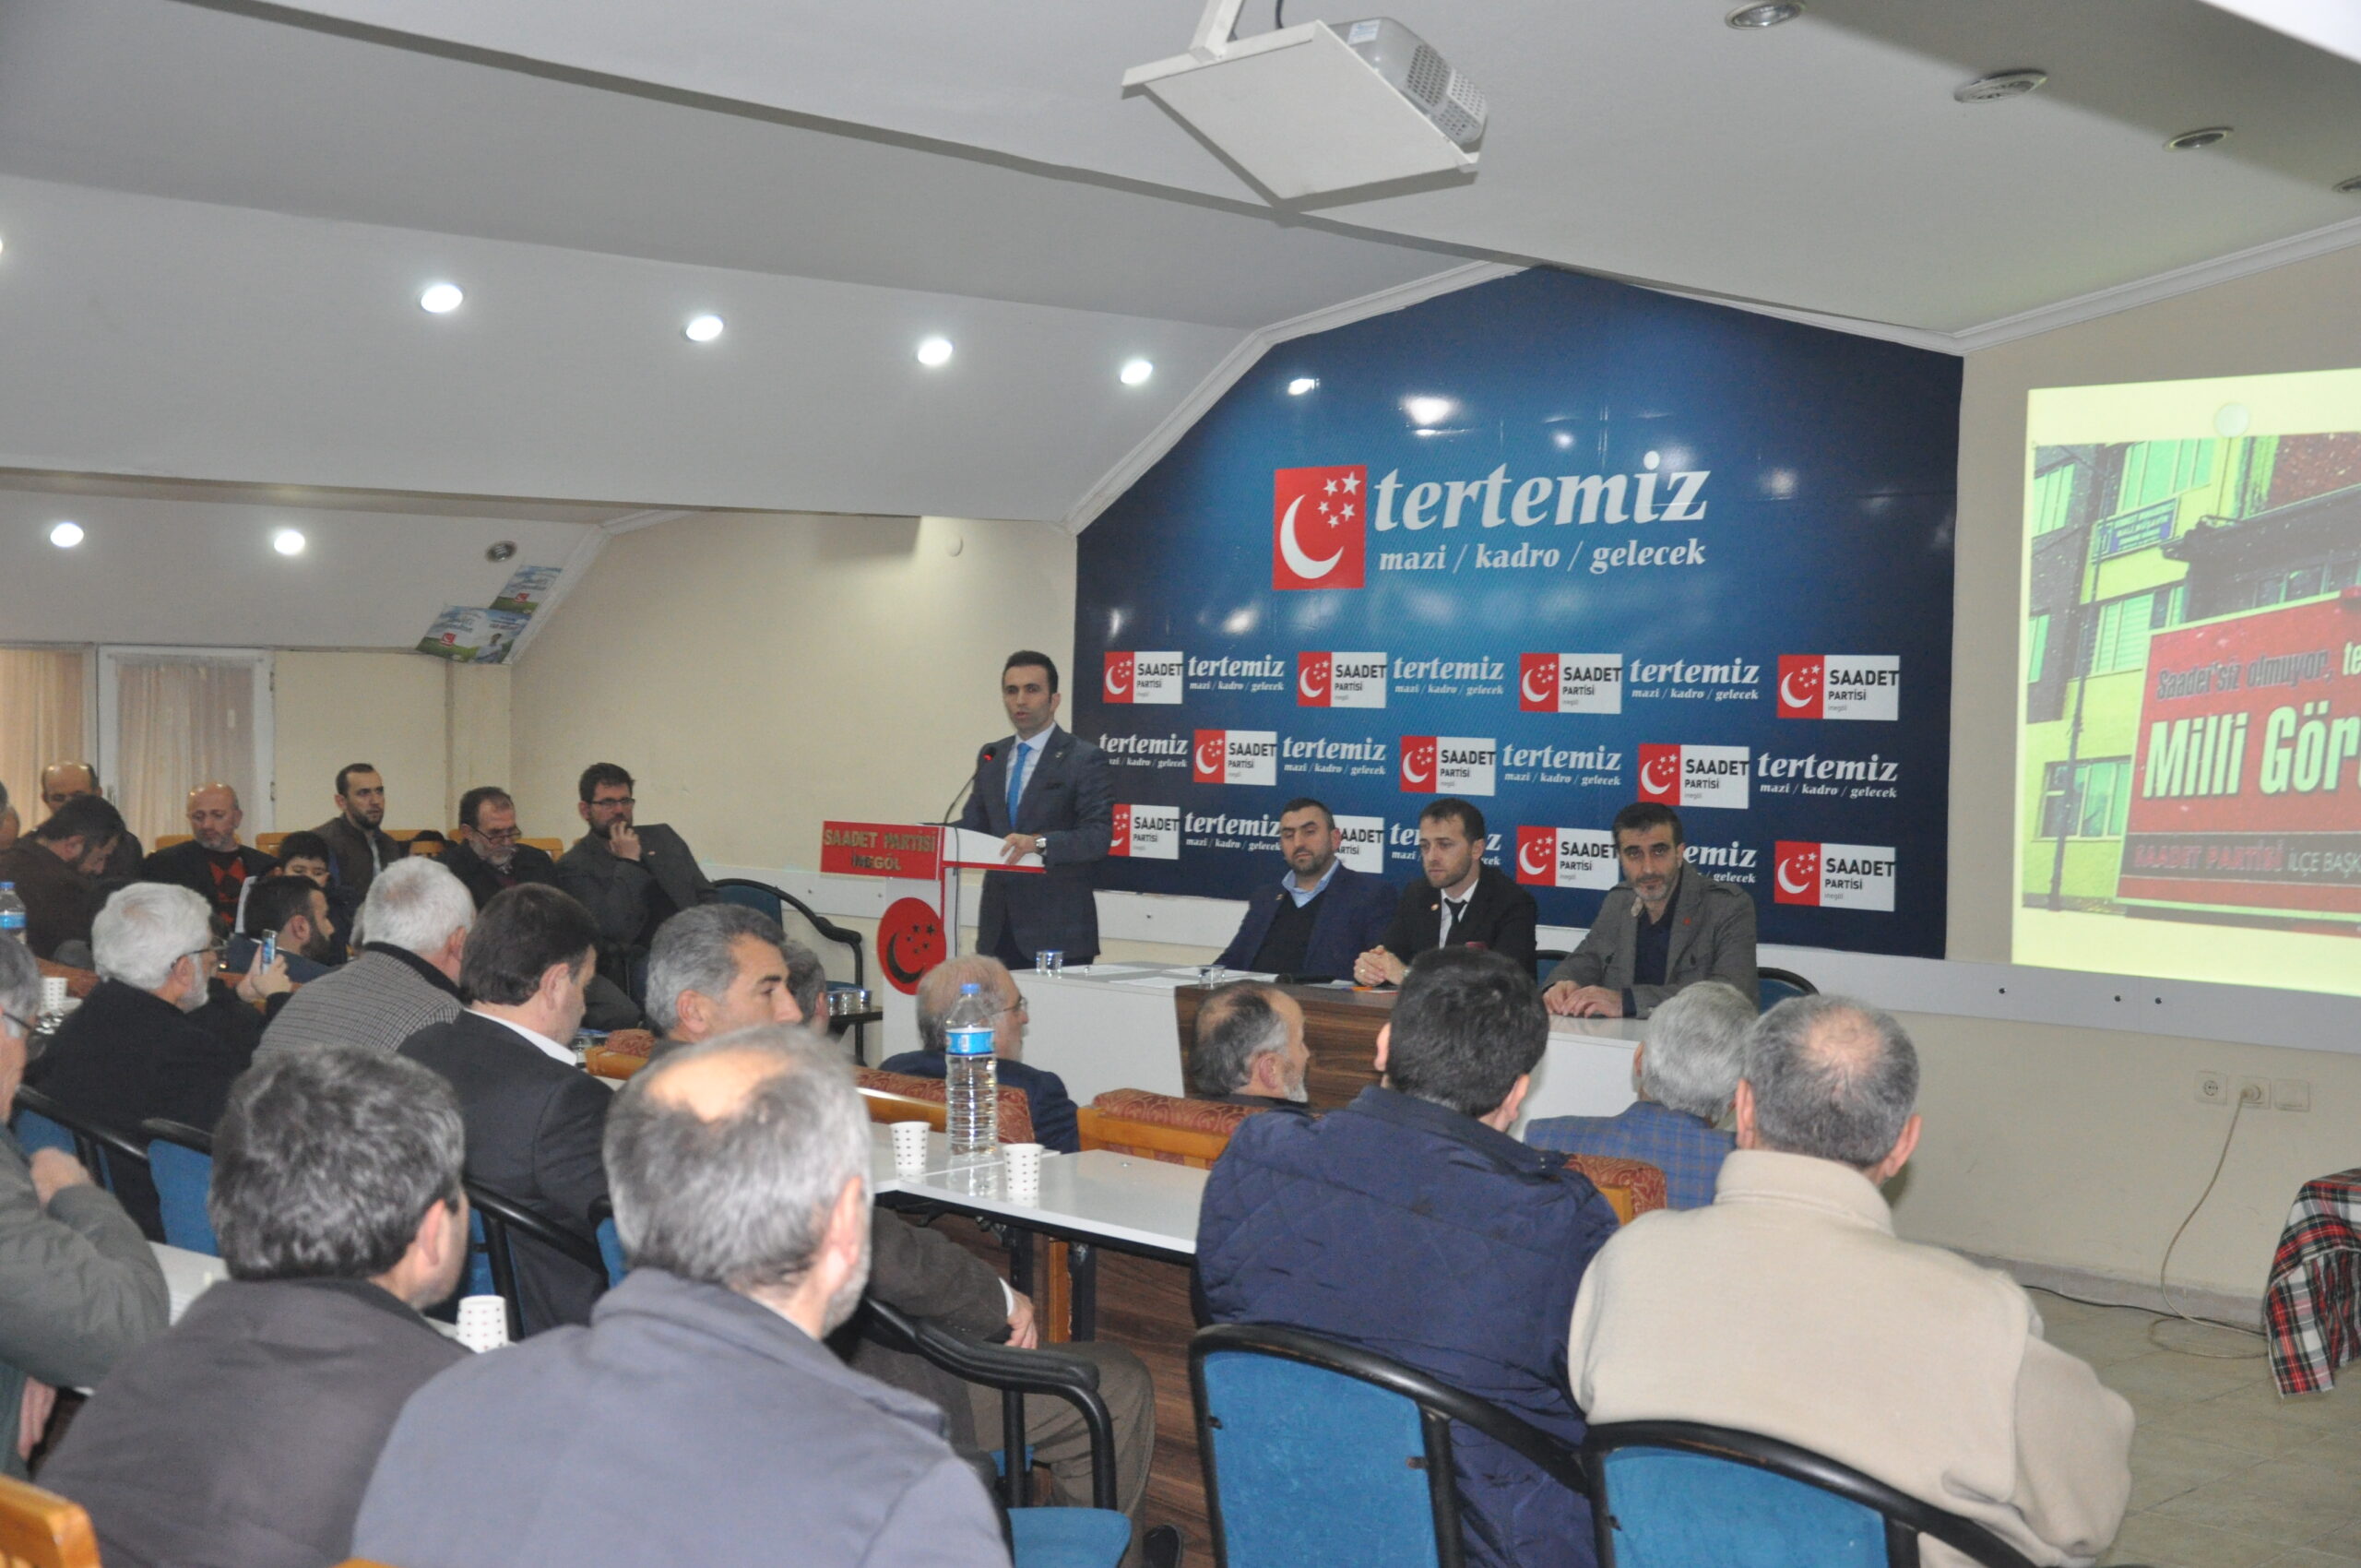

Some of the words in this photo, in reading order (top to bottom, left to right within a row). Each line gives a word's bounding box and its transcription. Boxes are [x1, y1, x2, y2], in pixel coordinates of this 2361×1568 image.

[1375, 450, 1711, 531] tertemiz
[1379, 544, 1446, 570] mazi
[1476, 542, 1559, 569] kadro
[1589, 539, 1706, 575] gelecek
[1137, 663, 1183, 676] SAADET
[1188, 654, 1285, 677] tertemiz
[1335, 664, 1387, 678] SAADET
[1393, 656, 1505, 680] tertemiz
[1630, 658, 1760, 683] tertemiz
[1563, 667, 1622, 682] SAADET
[1830, 670, 1900, 686] SAADET
[1631, 688, 1660, 698] mazi
[1670, 688, 1704, 699] kadro
[1715, 689, 1759, 702] gelecek
[1828, 689, 1867, 701] PARTİSİ
[1099, 733, 1188, 754] tertemiz
[1228, 742, 1276, 757] SAADET
[1282, 736, 1386, 761] tertemiz
[2142, 712, 2248, 798] Milli
[2260, 700, 2361, 794] Gör
[1441, 750, 1496, 765] SAADET
[1502, 743, 1622, 771] tertemiz
[1686, 759, 1750, 776] SAADET
[1757, 752, 1899, 782] tertemiz
[1504, 772, 1530, 781] mazi
[1540, 773, 1572, 783] kadro
[1581, 775, 1621, 786] gelecek
[1684, 778, 1719, 790] PARTİSİ
[1760, 783, 1789, 793] mazi
[1801, 783, 1838, 796] kadro
[1849, 786, 1897, 799] gelecek
[1134, 816, 1180, 831] SAADET
[1184, 812, 1281, 837] tertemiz
[824, 829, 878, 849] SAADET
[1341, 828, 1384, 843] AADET
[1560, 841, 1618, 859] SAADET
[1826, 858, 1895, 877] SAADET
[1825, 878, 1862, 890] PARTİSİ
